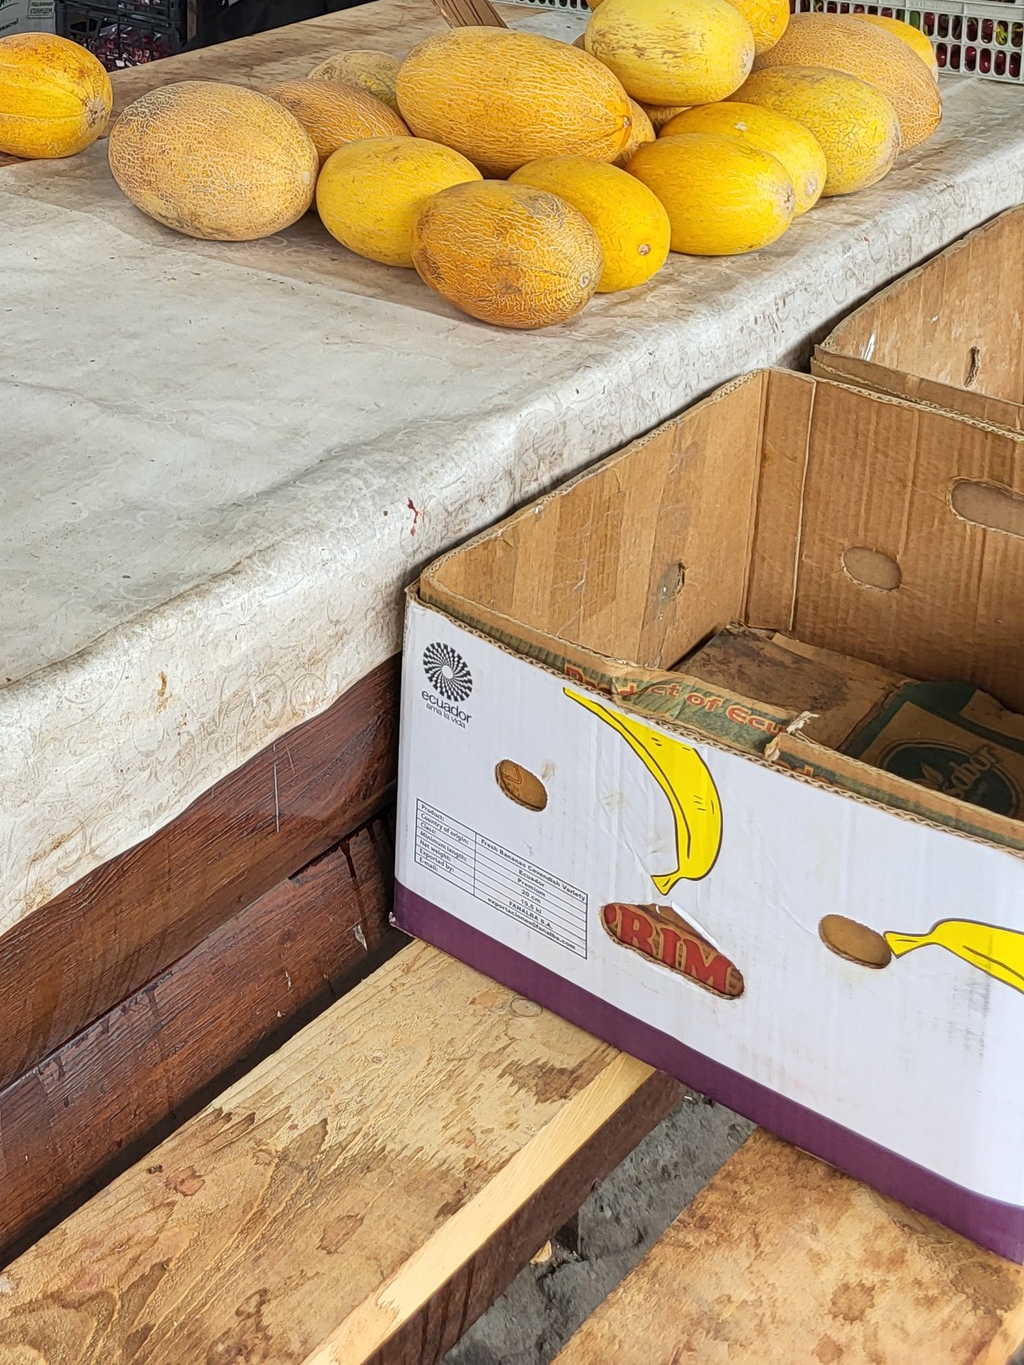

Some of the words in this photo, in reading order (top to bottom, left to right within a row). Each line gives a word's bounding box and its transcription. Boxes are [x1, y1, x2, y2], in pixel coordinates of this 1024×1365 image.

[421, 690, 472, 723] ecuador
[425, 702, 443, 717] ama
[443, 711, 451, 721] la
[451, 715, 466, 729] vida
[687, 690, 722, 714] of
[726, 705, 786, 735] Ecu
[421, 803, 445, 822] Product:
[420, 821, 437, 835] Class:
[421, 812, 443, 831] Country
[443, 826, 450, 835] of
[450, 831, 469, 845] origin:
[420, 830, 446, 850] Minimum
[447, 846, 468, 862] length:
[419, 848, 445, 869] Exported
[480, 838, 499, 853] Fresh
[499, 849, 526, 869] Bananas
[527, 862, 561, 888] Cavendish
[562, 884, 586, 903] Variety
[517, 878, 546, 899] Premium
[518, 868, 546, 888] Ecuador
[530, 894, 542, 905] cm
